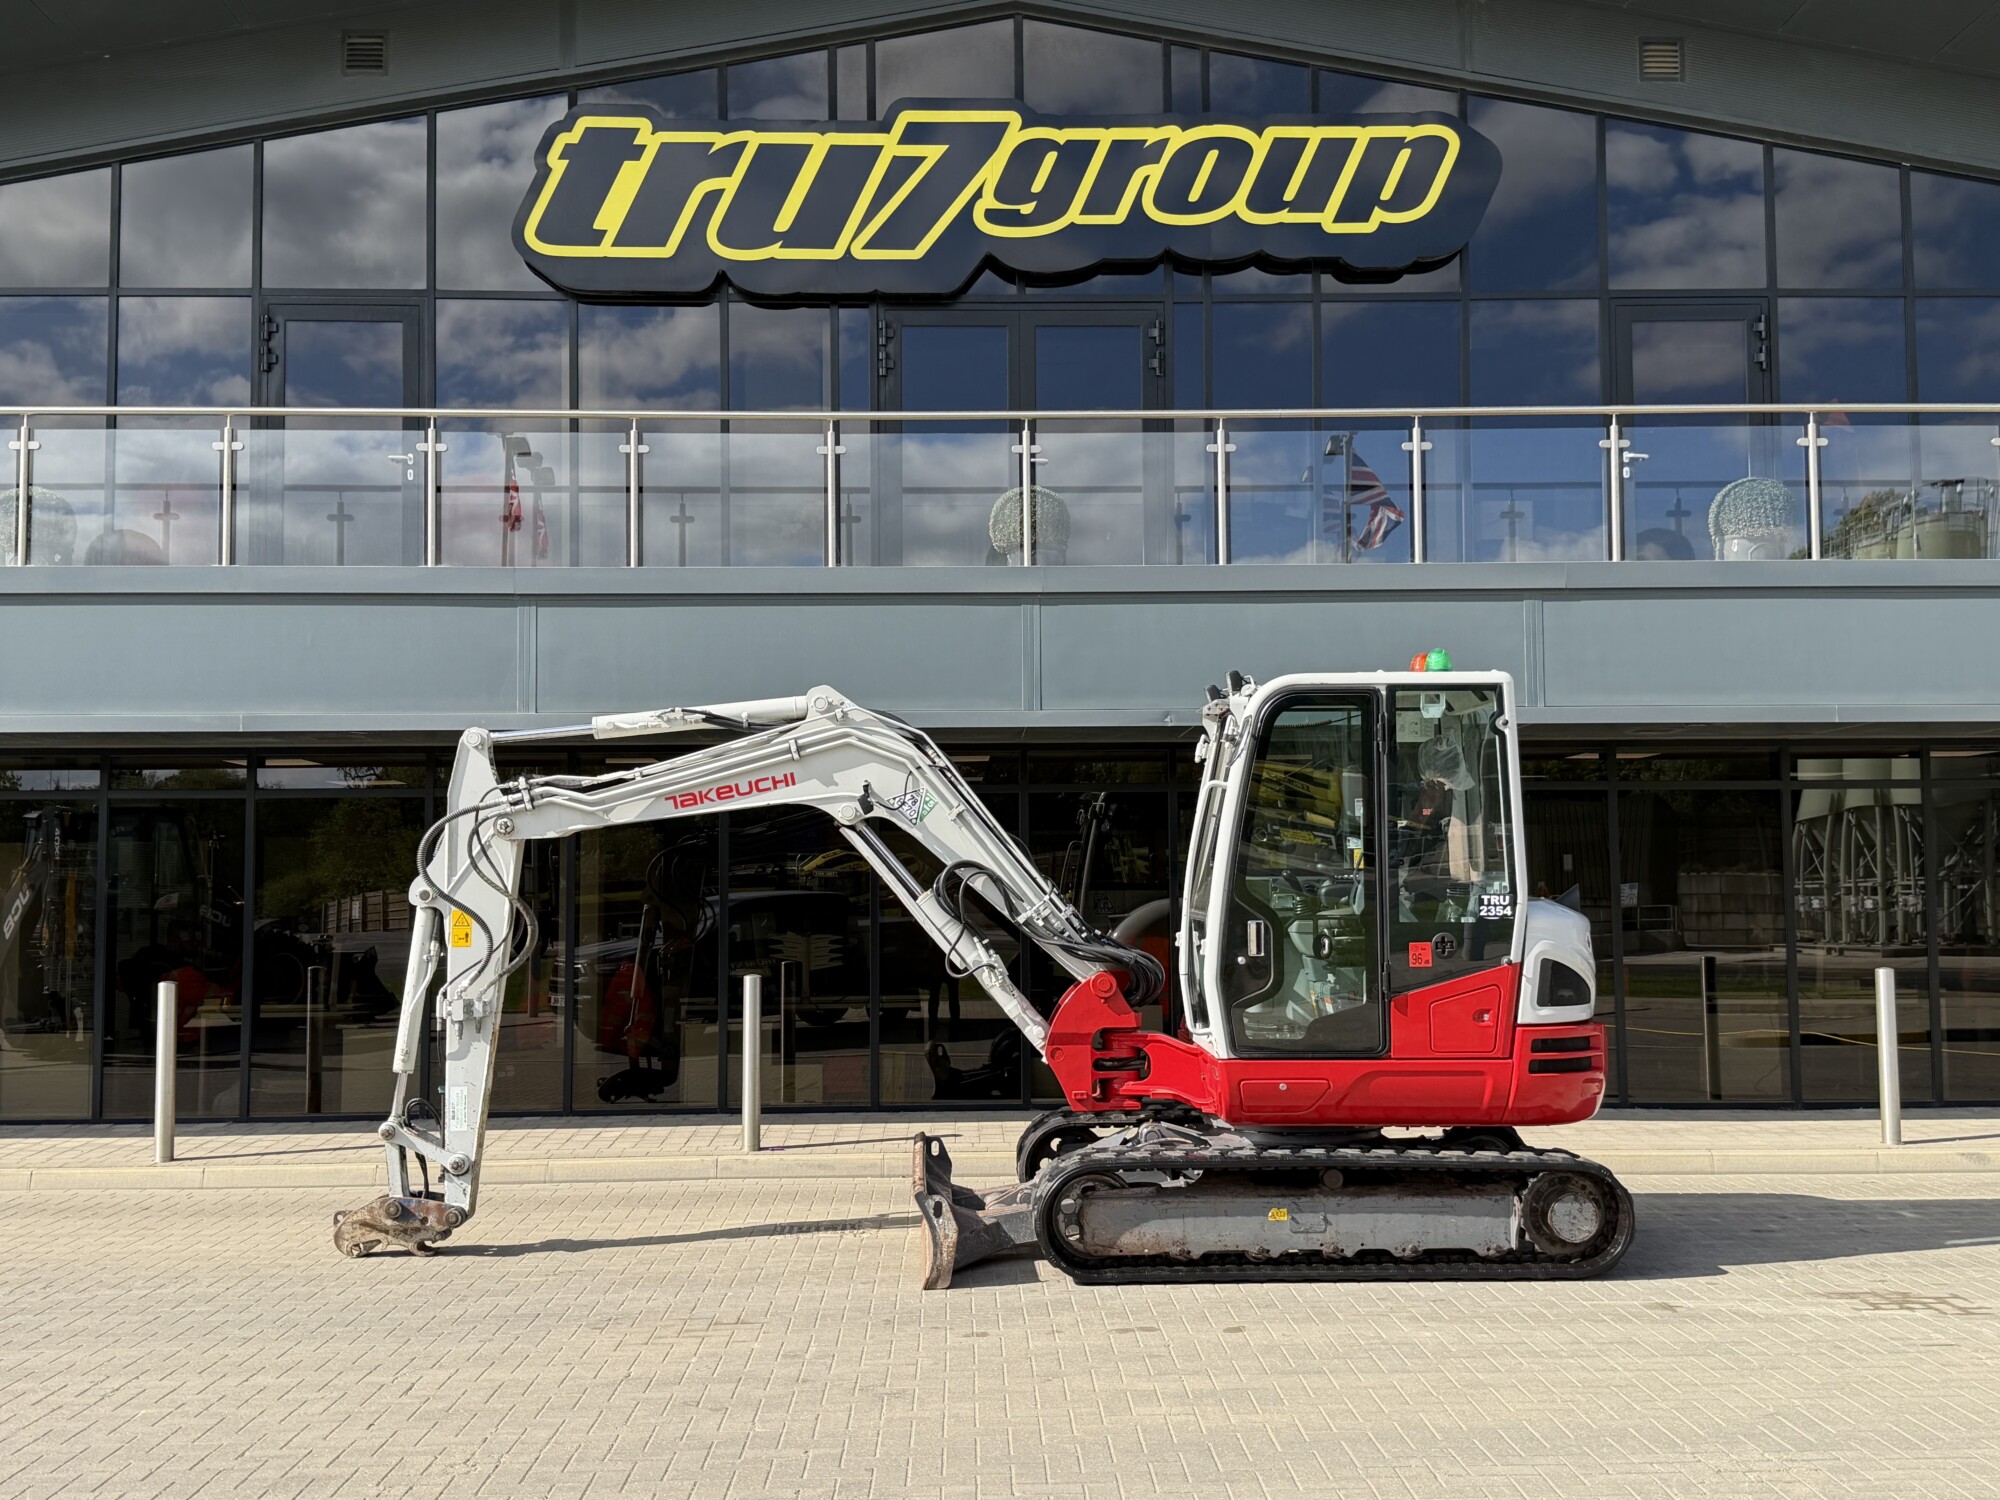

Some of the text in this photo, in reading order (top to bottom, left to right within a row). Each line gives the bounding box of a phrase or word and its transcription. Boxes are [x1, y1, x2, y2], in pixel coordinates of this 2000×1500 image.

[1480, 894, 1510, 906] TRU
[1479, 905, 1512, 917] 2354
[1411, 952, 1423, 965] 96
